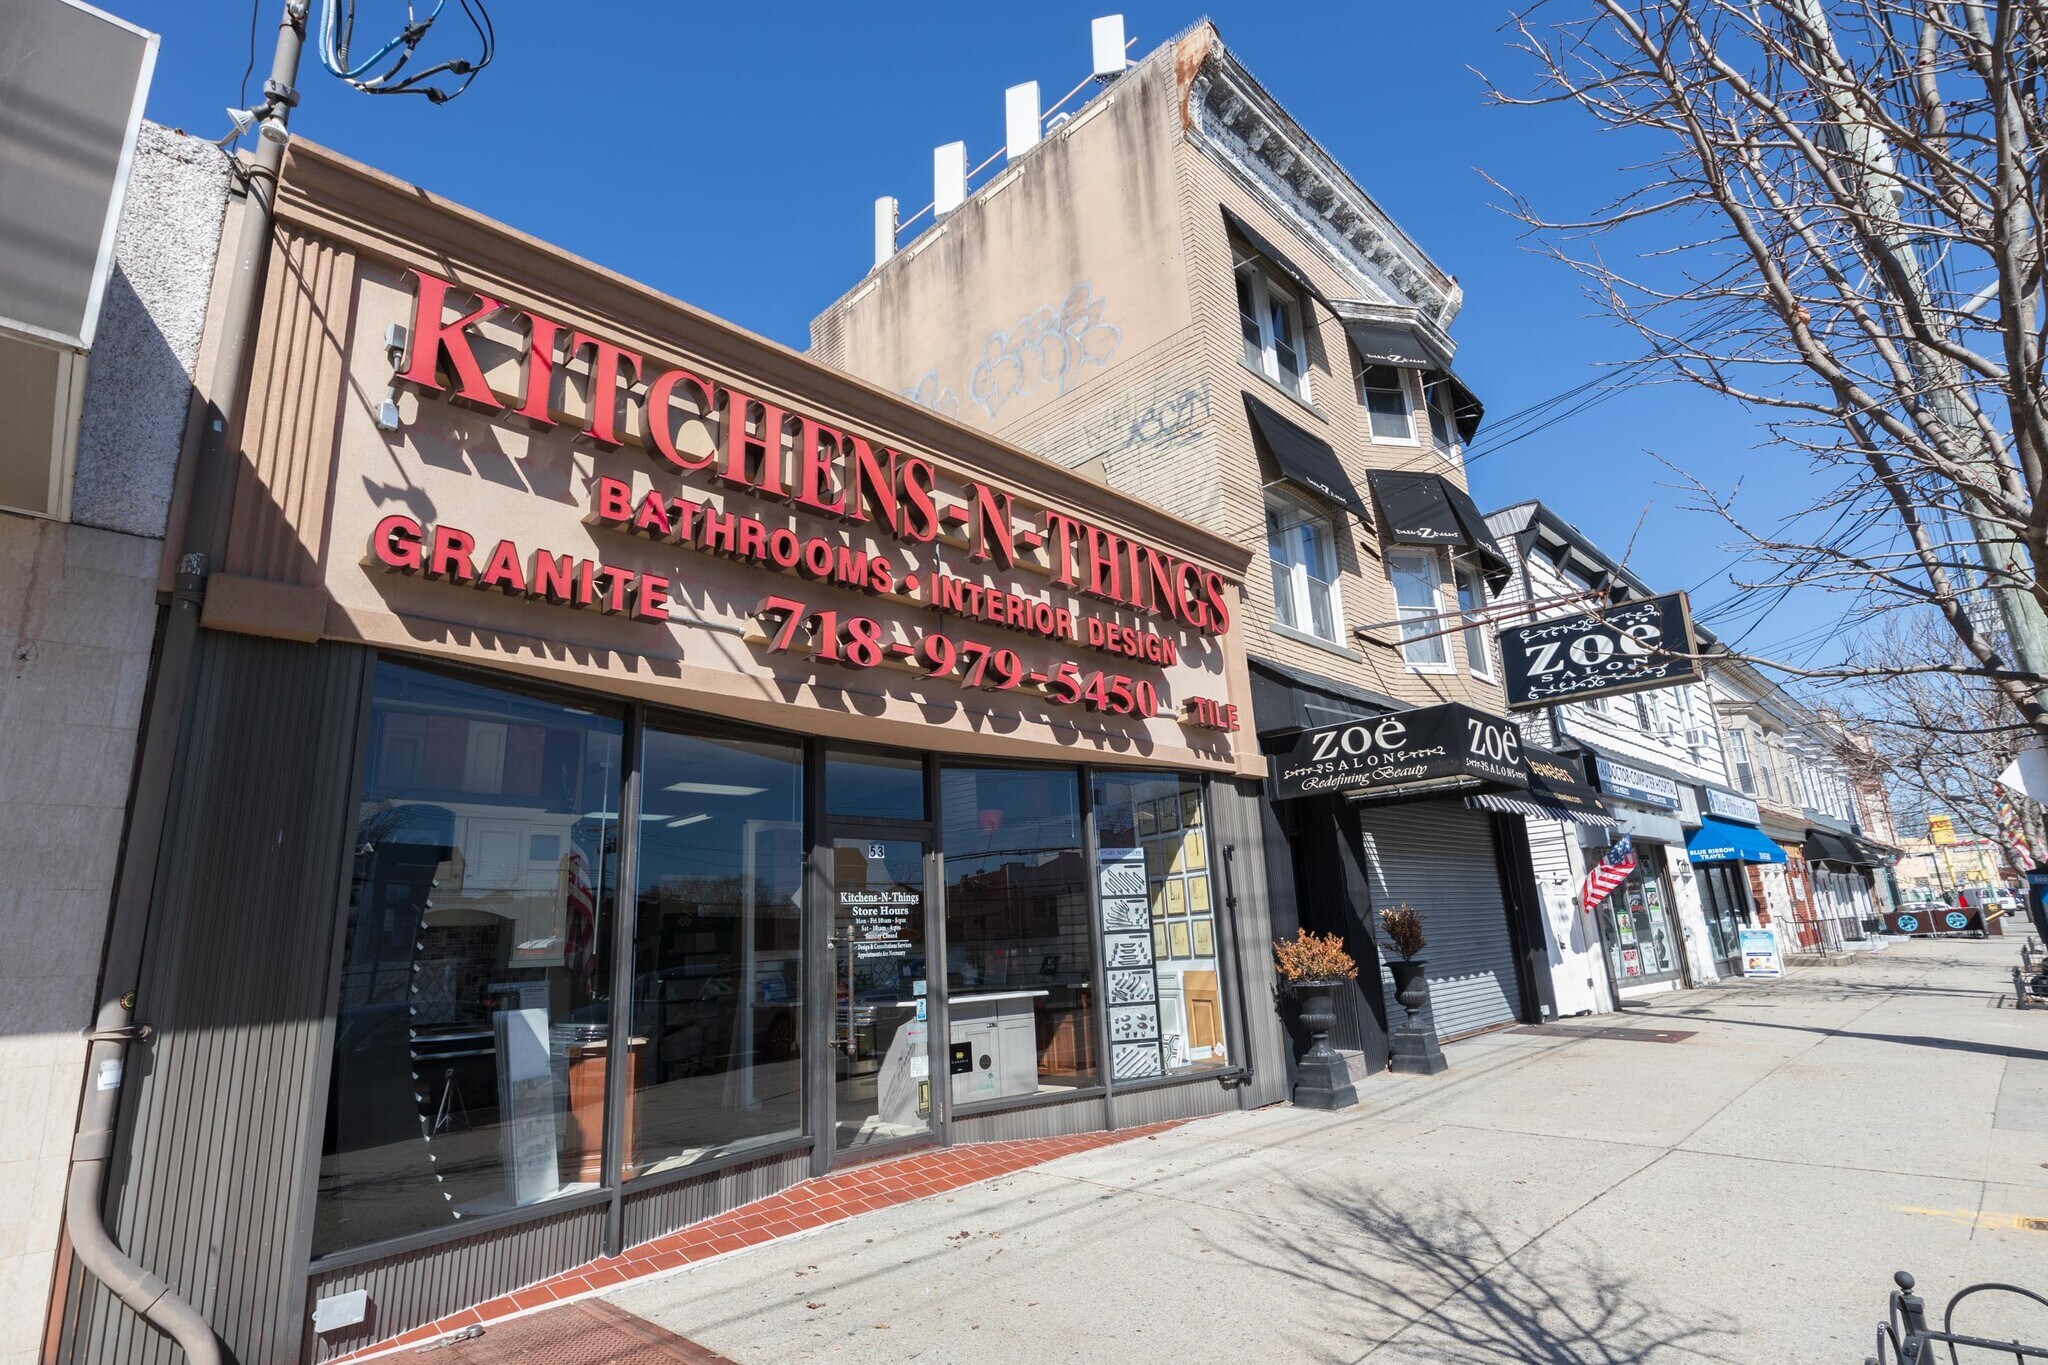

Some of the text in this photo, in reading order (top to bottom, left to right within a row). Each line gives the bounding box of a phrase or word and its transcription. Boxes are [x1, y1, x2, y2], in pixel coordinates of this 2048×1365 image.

[396, 267, 1230, 636] KITCHENS-N-THINGS
[374, 514, 669, 620] GRANITE
[599, 476, 1177, 667] BATHROOMS INTERIOR DESIGN
[766, 594, 1158, 718] 718-979-5450
[1541, 653, 1649, 682] SALON
[1194, 696, 1241, 732] TILE
[1325, 753, 1395, 773] SALON
[1485, 762, 1513, 777] SALON
[1523, 755, 1575, 784] Jewelers
[1302, 765, 1427, 790] Redefining Beauty
[869, 845, 885, 858] 53
[1689, 848, 1706, 856] BLUE
[852, 906, 909, 916] Store Hours
[865, 932, 882, 940] Sunday
